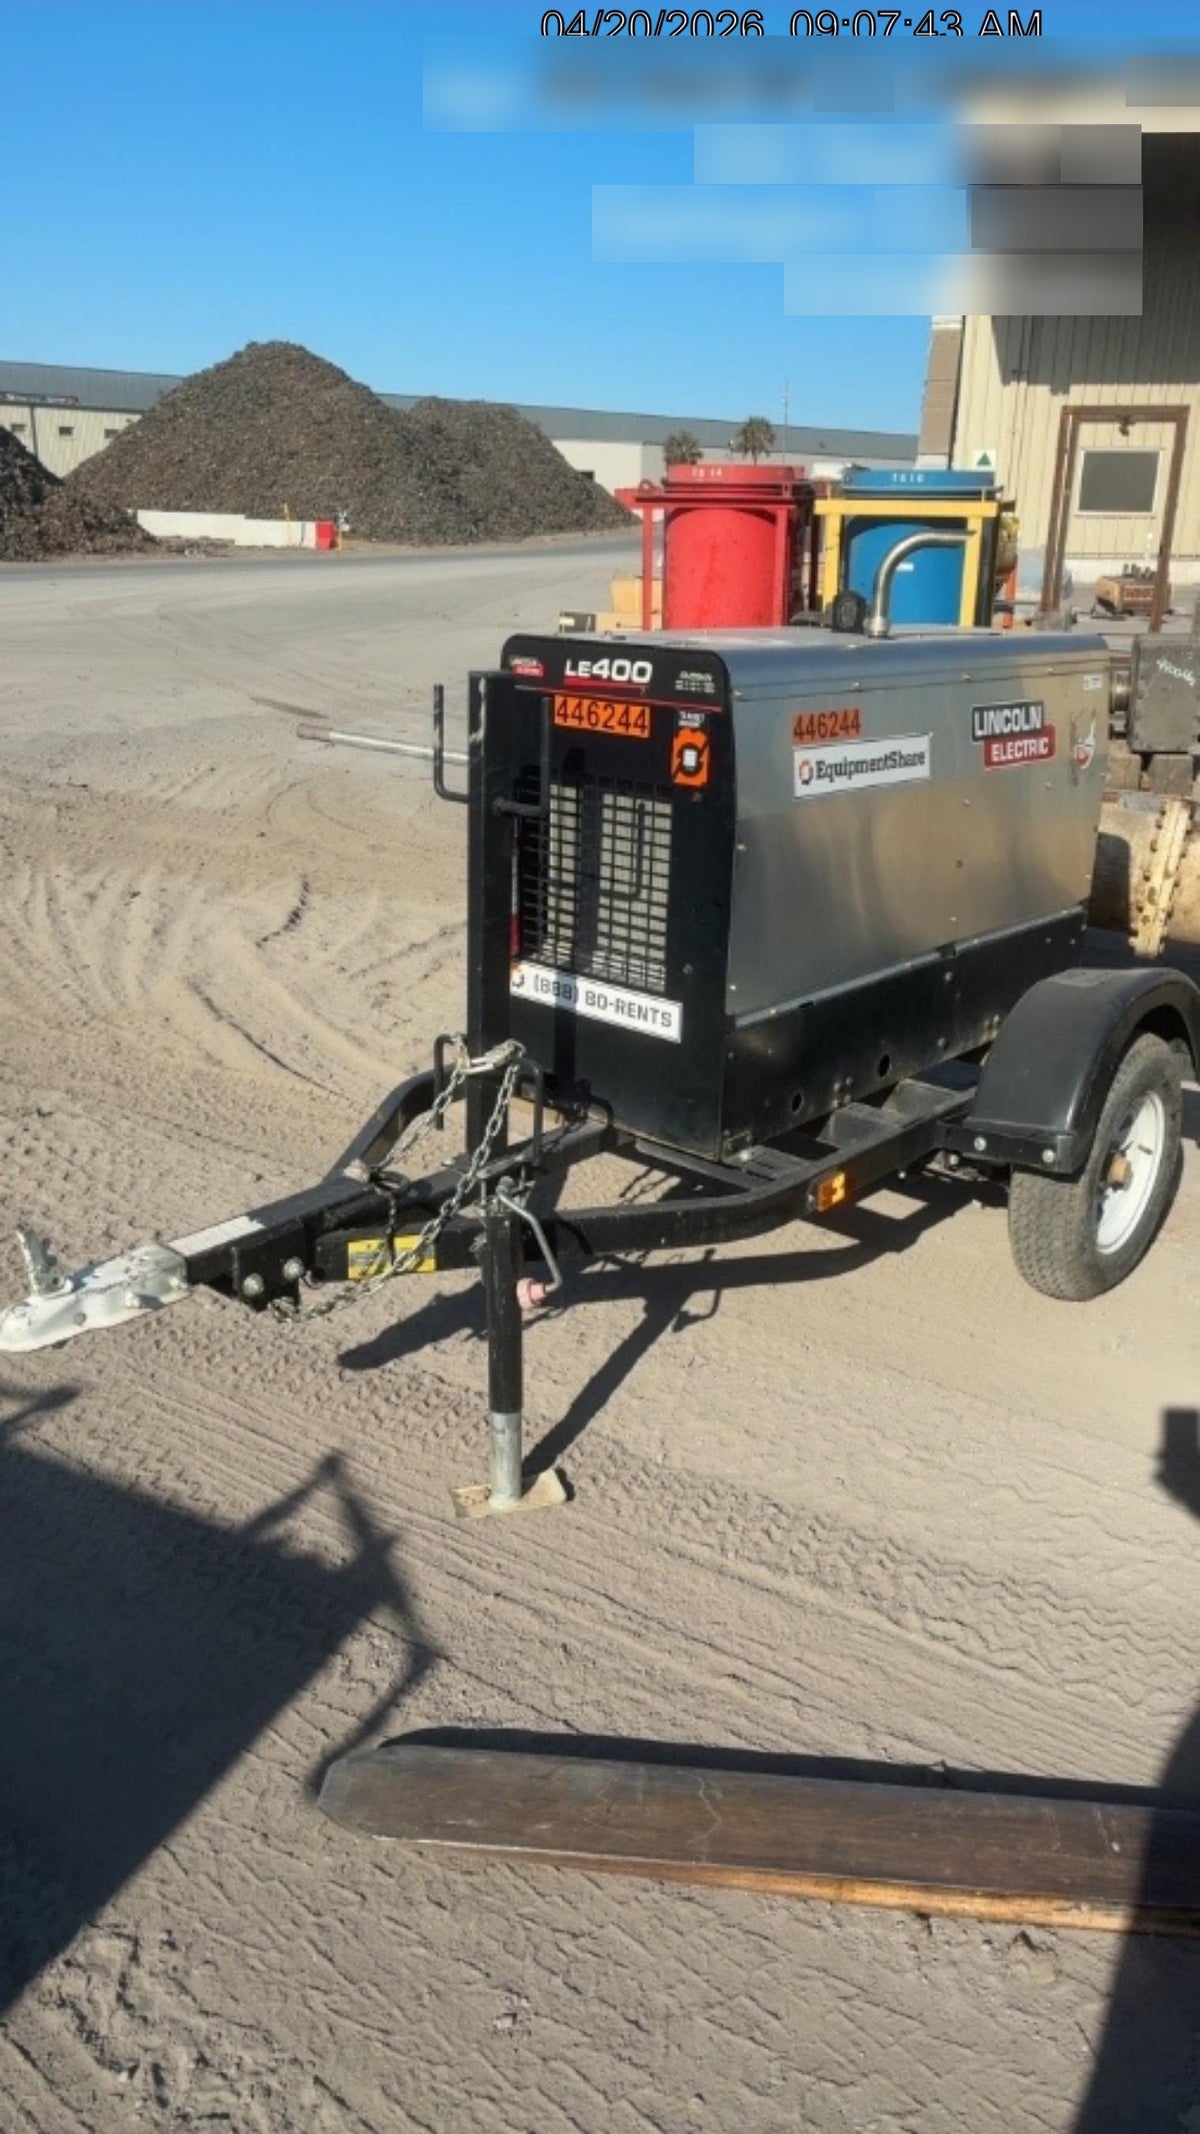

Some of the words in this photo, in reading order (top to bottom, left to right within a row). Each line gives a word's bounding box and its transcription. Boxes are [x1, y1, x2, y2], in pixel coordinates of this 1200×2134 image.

[564, 658, 653, 683] LE400
[556, 698, 648, 733] 446244
[793, 708, 861, 741] 446244
[974, 705, 1042, 736] LINCOLN
[991, 737, 1050, 763] ELECTRIC
[814, 750, 926, 783] EquipmentShare
